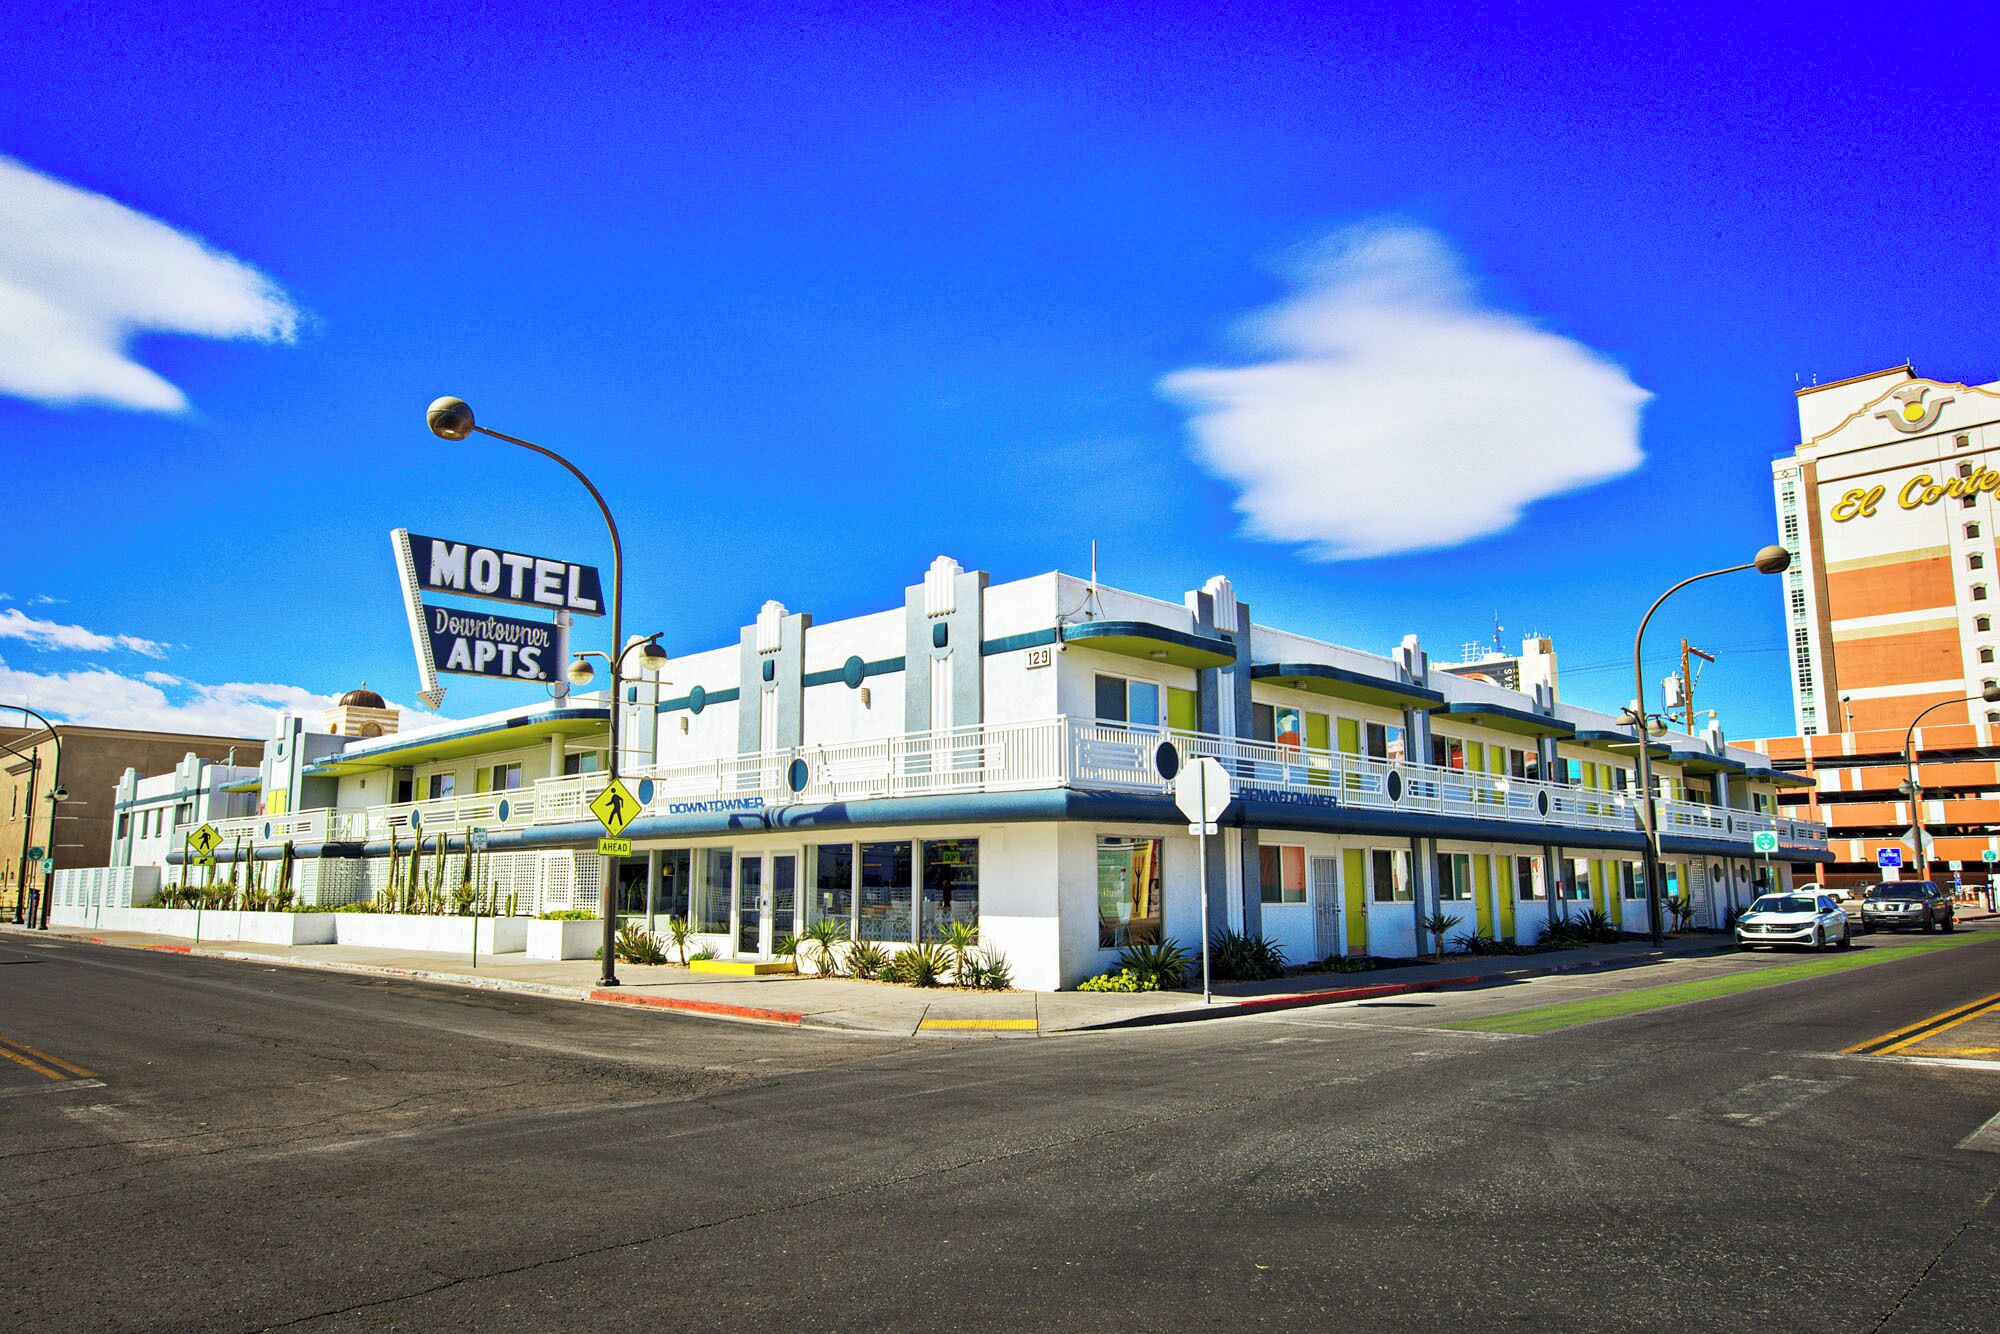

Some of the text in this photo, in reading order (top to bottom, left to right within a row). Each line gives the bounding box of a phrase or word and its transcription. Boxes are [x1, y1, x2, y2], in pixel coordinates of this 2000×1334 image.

[1831, 464, 2000, 522] El Corte
[430, 540, 597, 611] MOTEL
[434, 608, 550, 648] Downtowner
[446, 637, 547, 680] APTS.
[1029, 650, 1048, 666] 129
[669, 796, 766, 814] DOWNTOWNER
[1239, 787, 1338, 808] DOWNTOWNER
[602, 842, 628, 852] AHEAD
